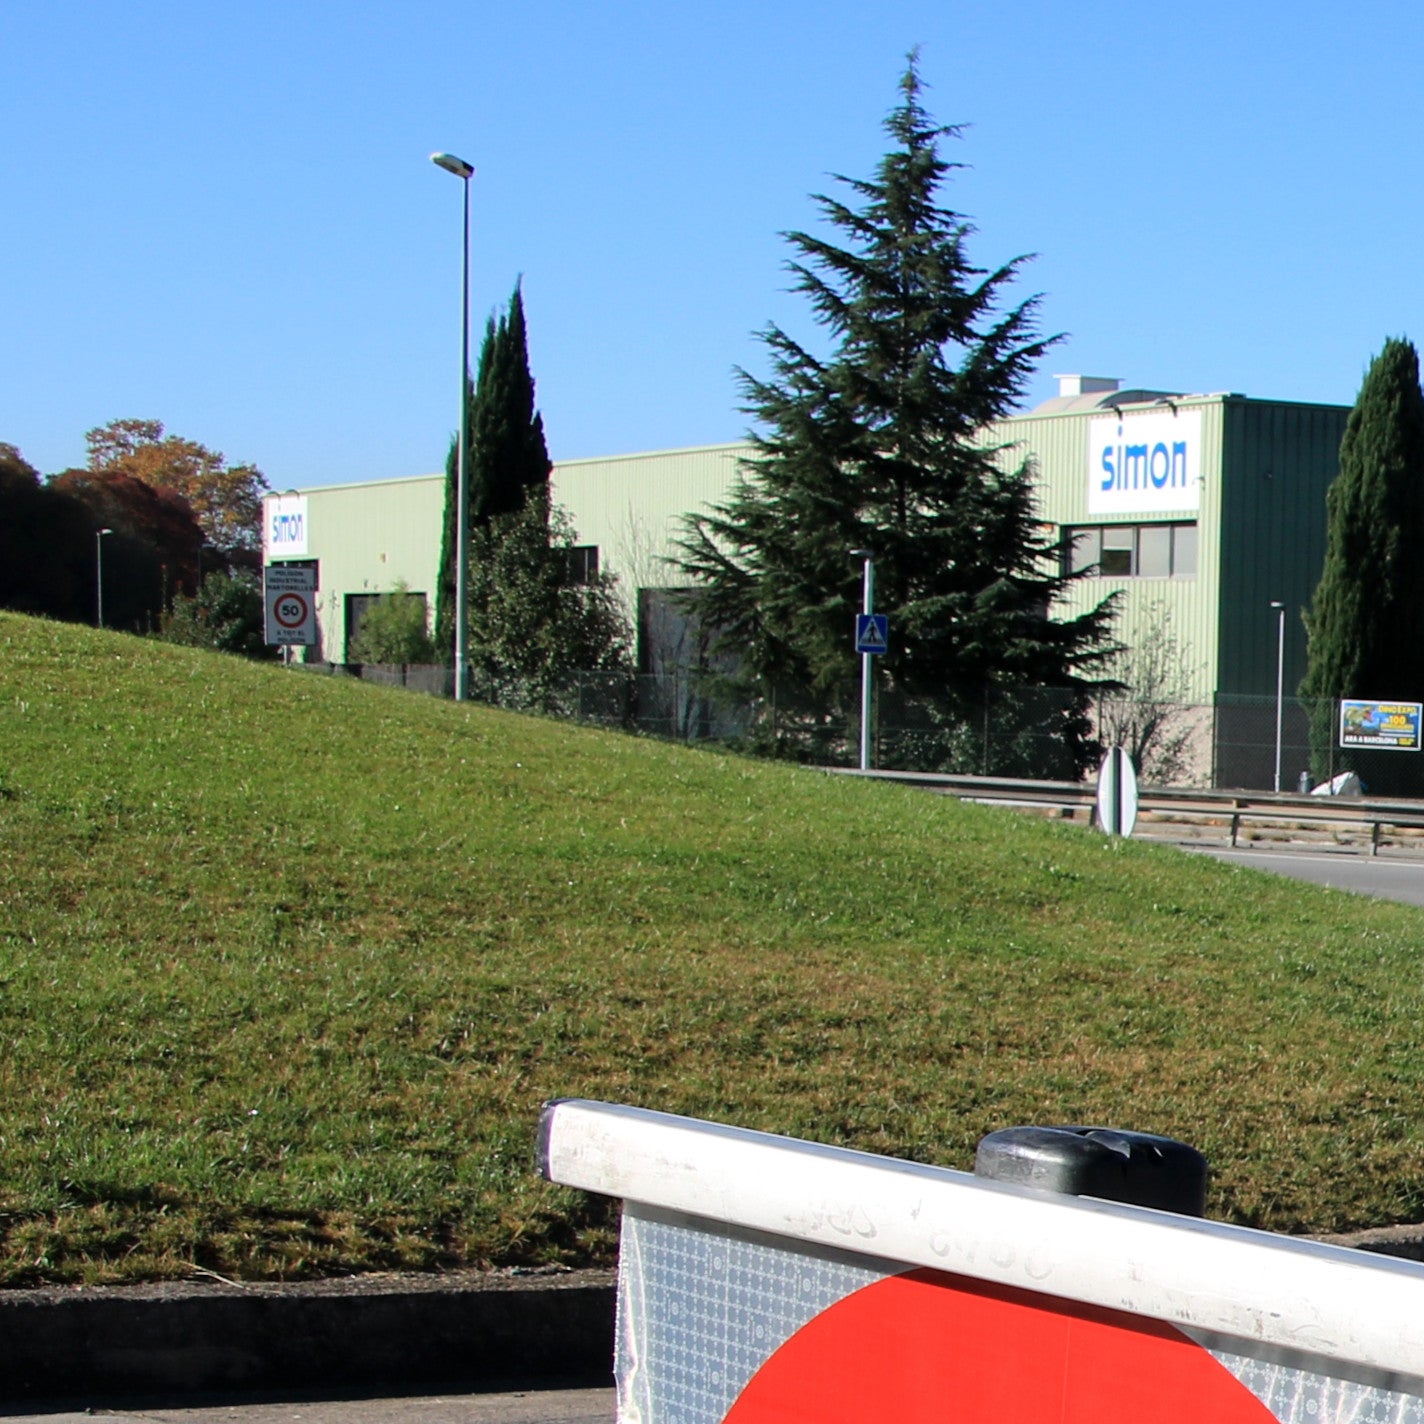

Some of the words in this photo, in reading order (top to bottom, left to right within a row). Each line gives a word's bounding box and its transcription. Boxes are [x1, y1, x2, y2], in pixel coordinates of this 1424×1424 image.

[1101, 425, 1186, 491] simon
[272, 507, 303, 543] simon
[282, 605, 299, 617] 50
